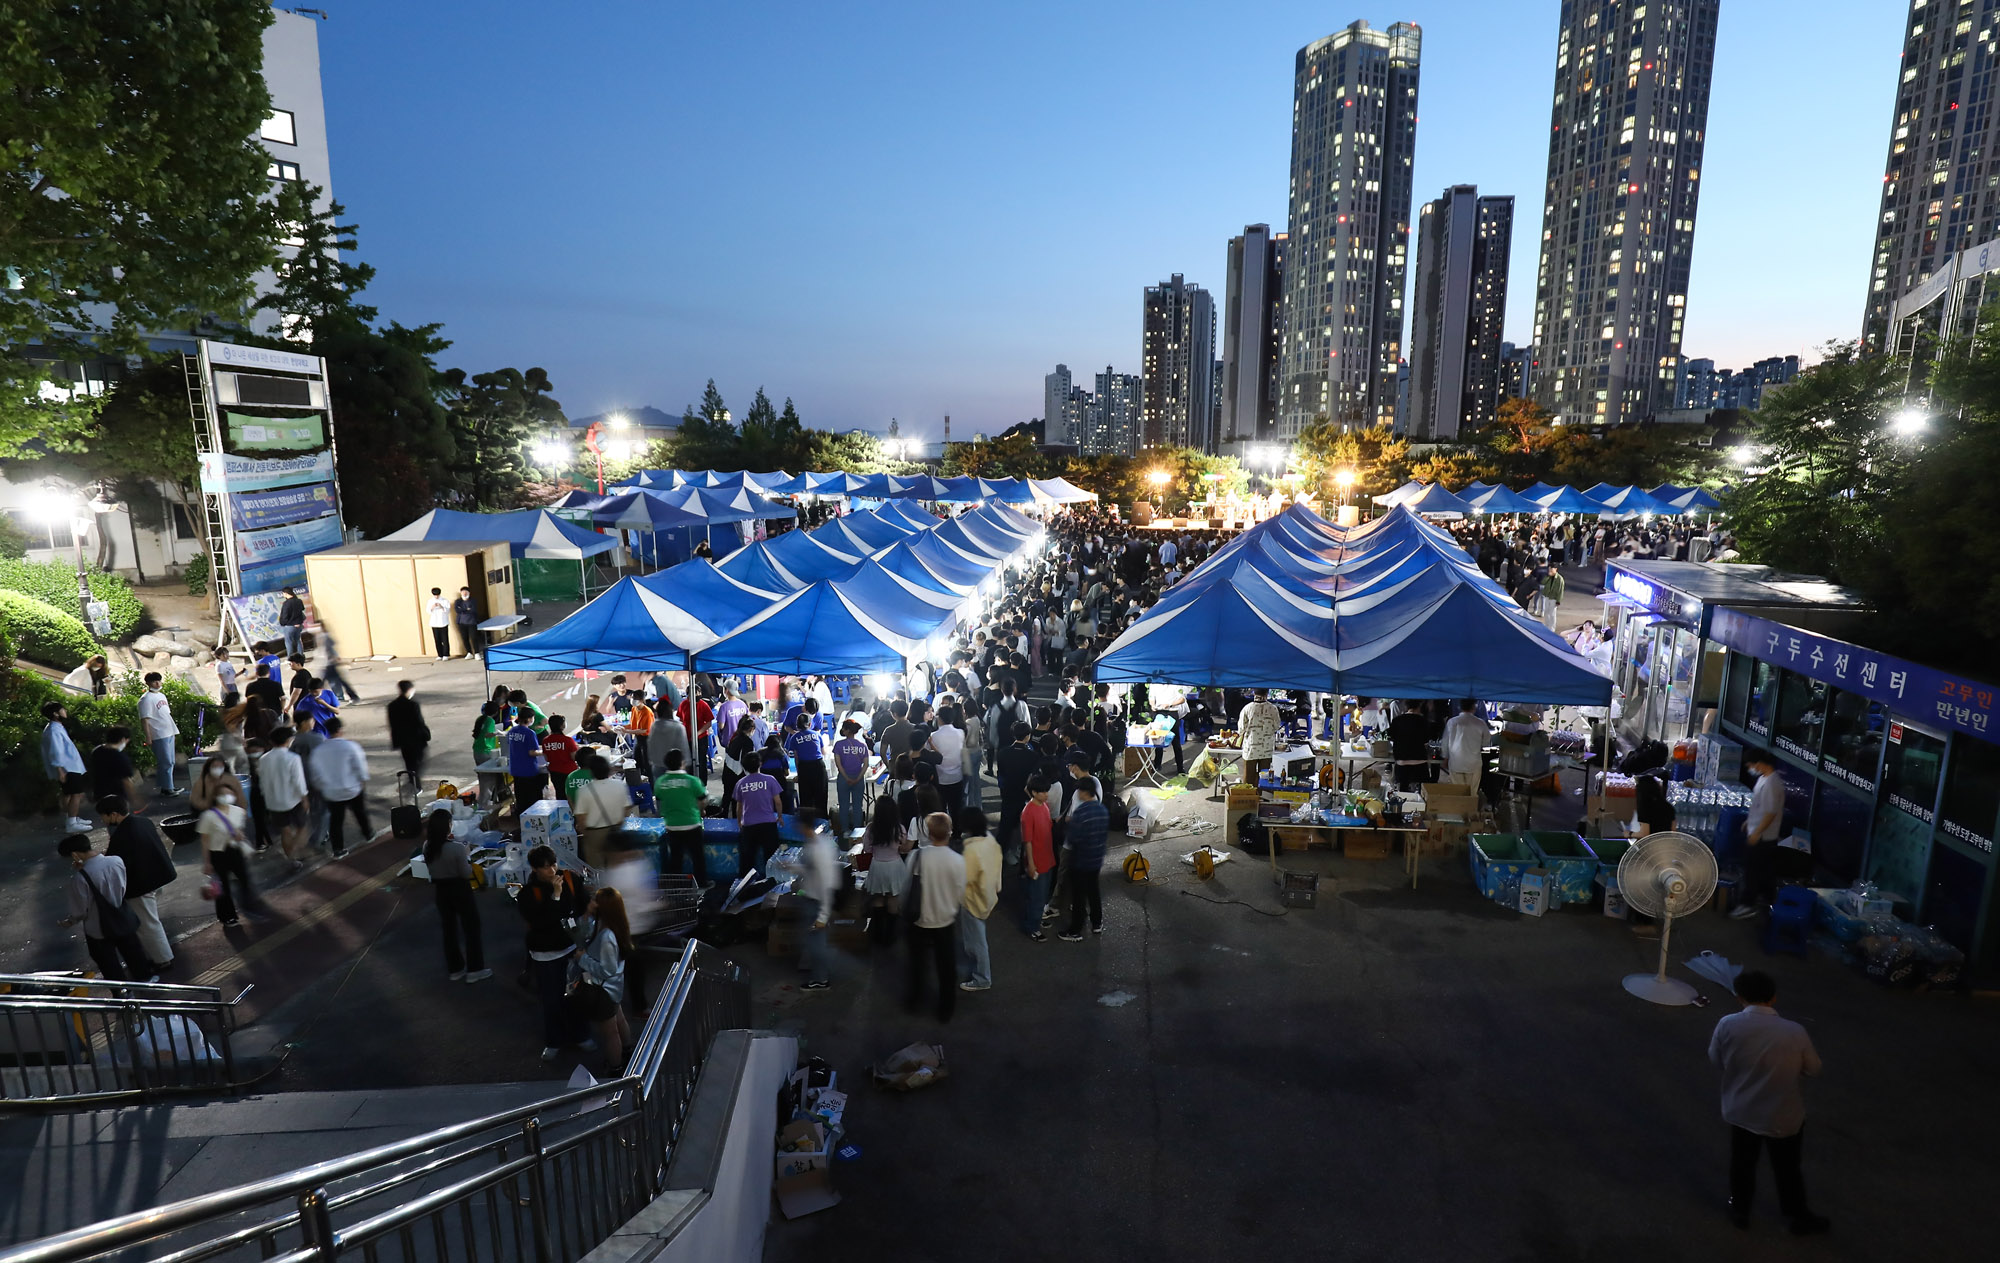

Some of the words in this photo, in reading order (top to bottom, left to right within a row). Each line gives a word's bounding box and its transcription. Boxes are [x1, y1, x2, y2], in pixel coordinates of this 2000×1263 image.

[1767, 631, 1907, 699] 구두수선센터
[1938, 680, 1993, 710] 고무인
[1936, 700, 1988, 733] 만년인
[508, 732, 525, 743] 난쟁이
[795, 732, 820, 744] 난쟁이
[543, 739, 565, 751] 난쟁이
[842, 745, 866, 756] 난쟁이
[740, 780, 768, 793] 난쟁이
[1960, 827, 1970, 841] 도장
[1969, 832, 1984, 849] 고무인
